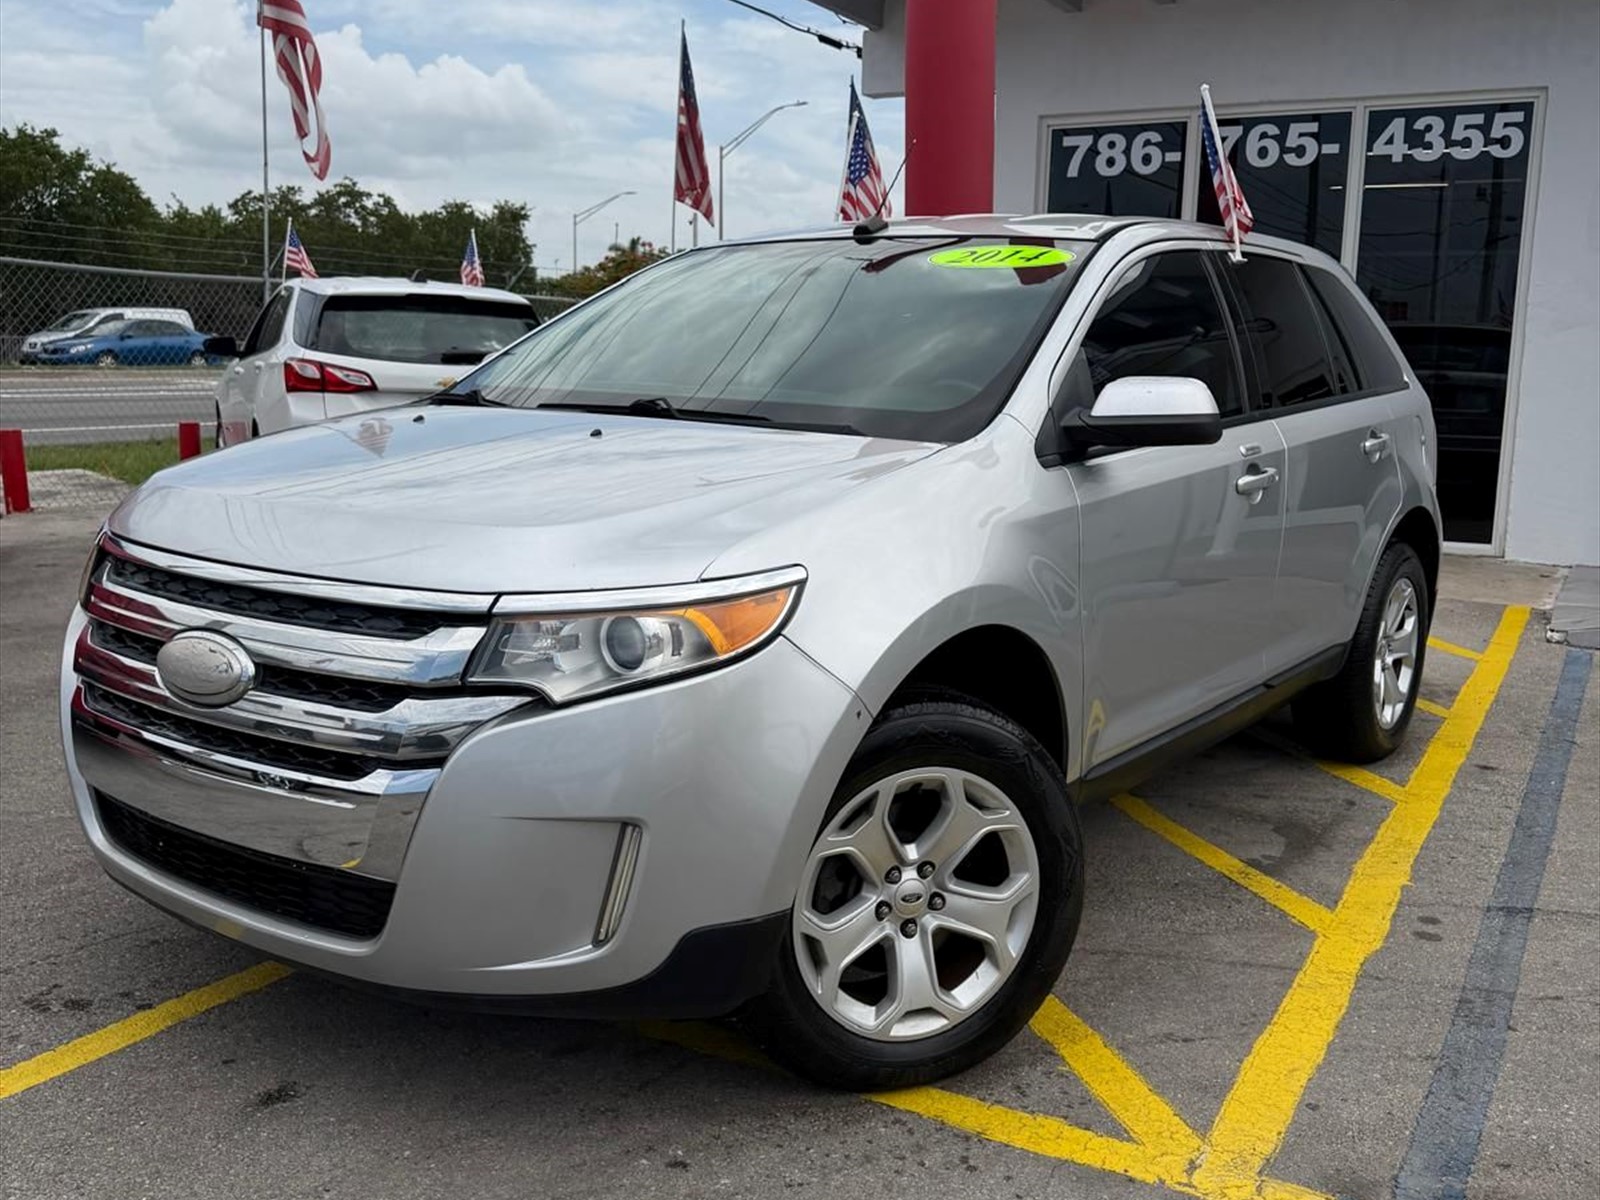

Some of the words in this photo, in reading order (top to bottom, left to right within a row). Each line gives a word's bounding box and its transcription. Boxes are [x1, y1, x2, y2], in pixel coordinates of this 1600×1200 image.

[1062, 131, 1182, 178] 786-
[1372, 111, 1525, 163] 4355
[946, 249, 1052, 264] 2014
